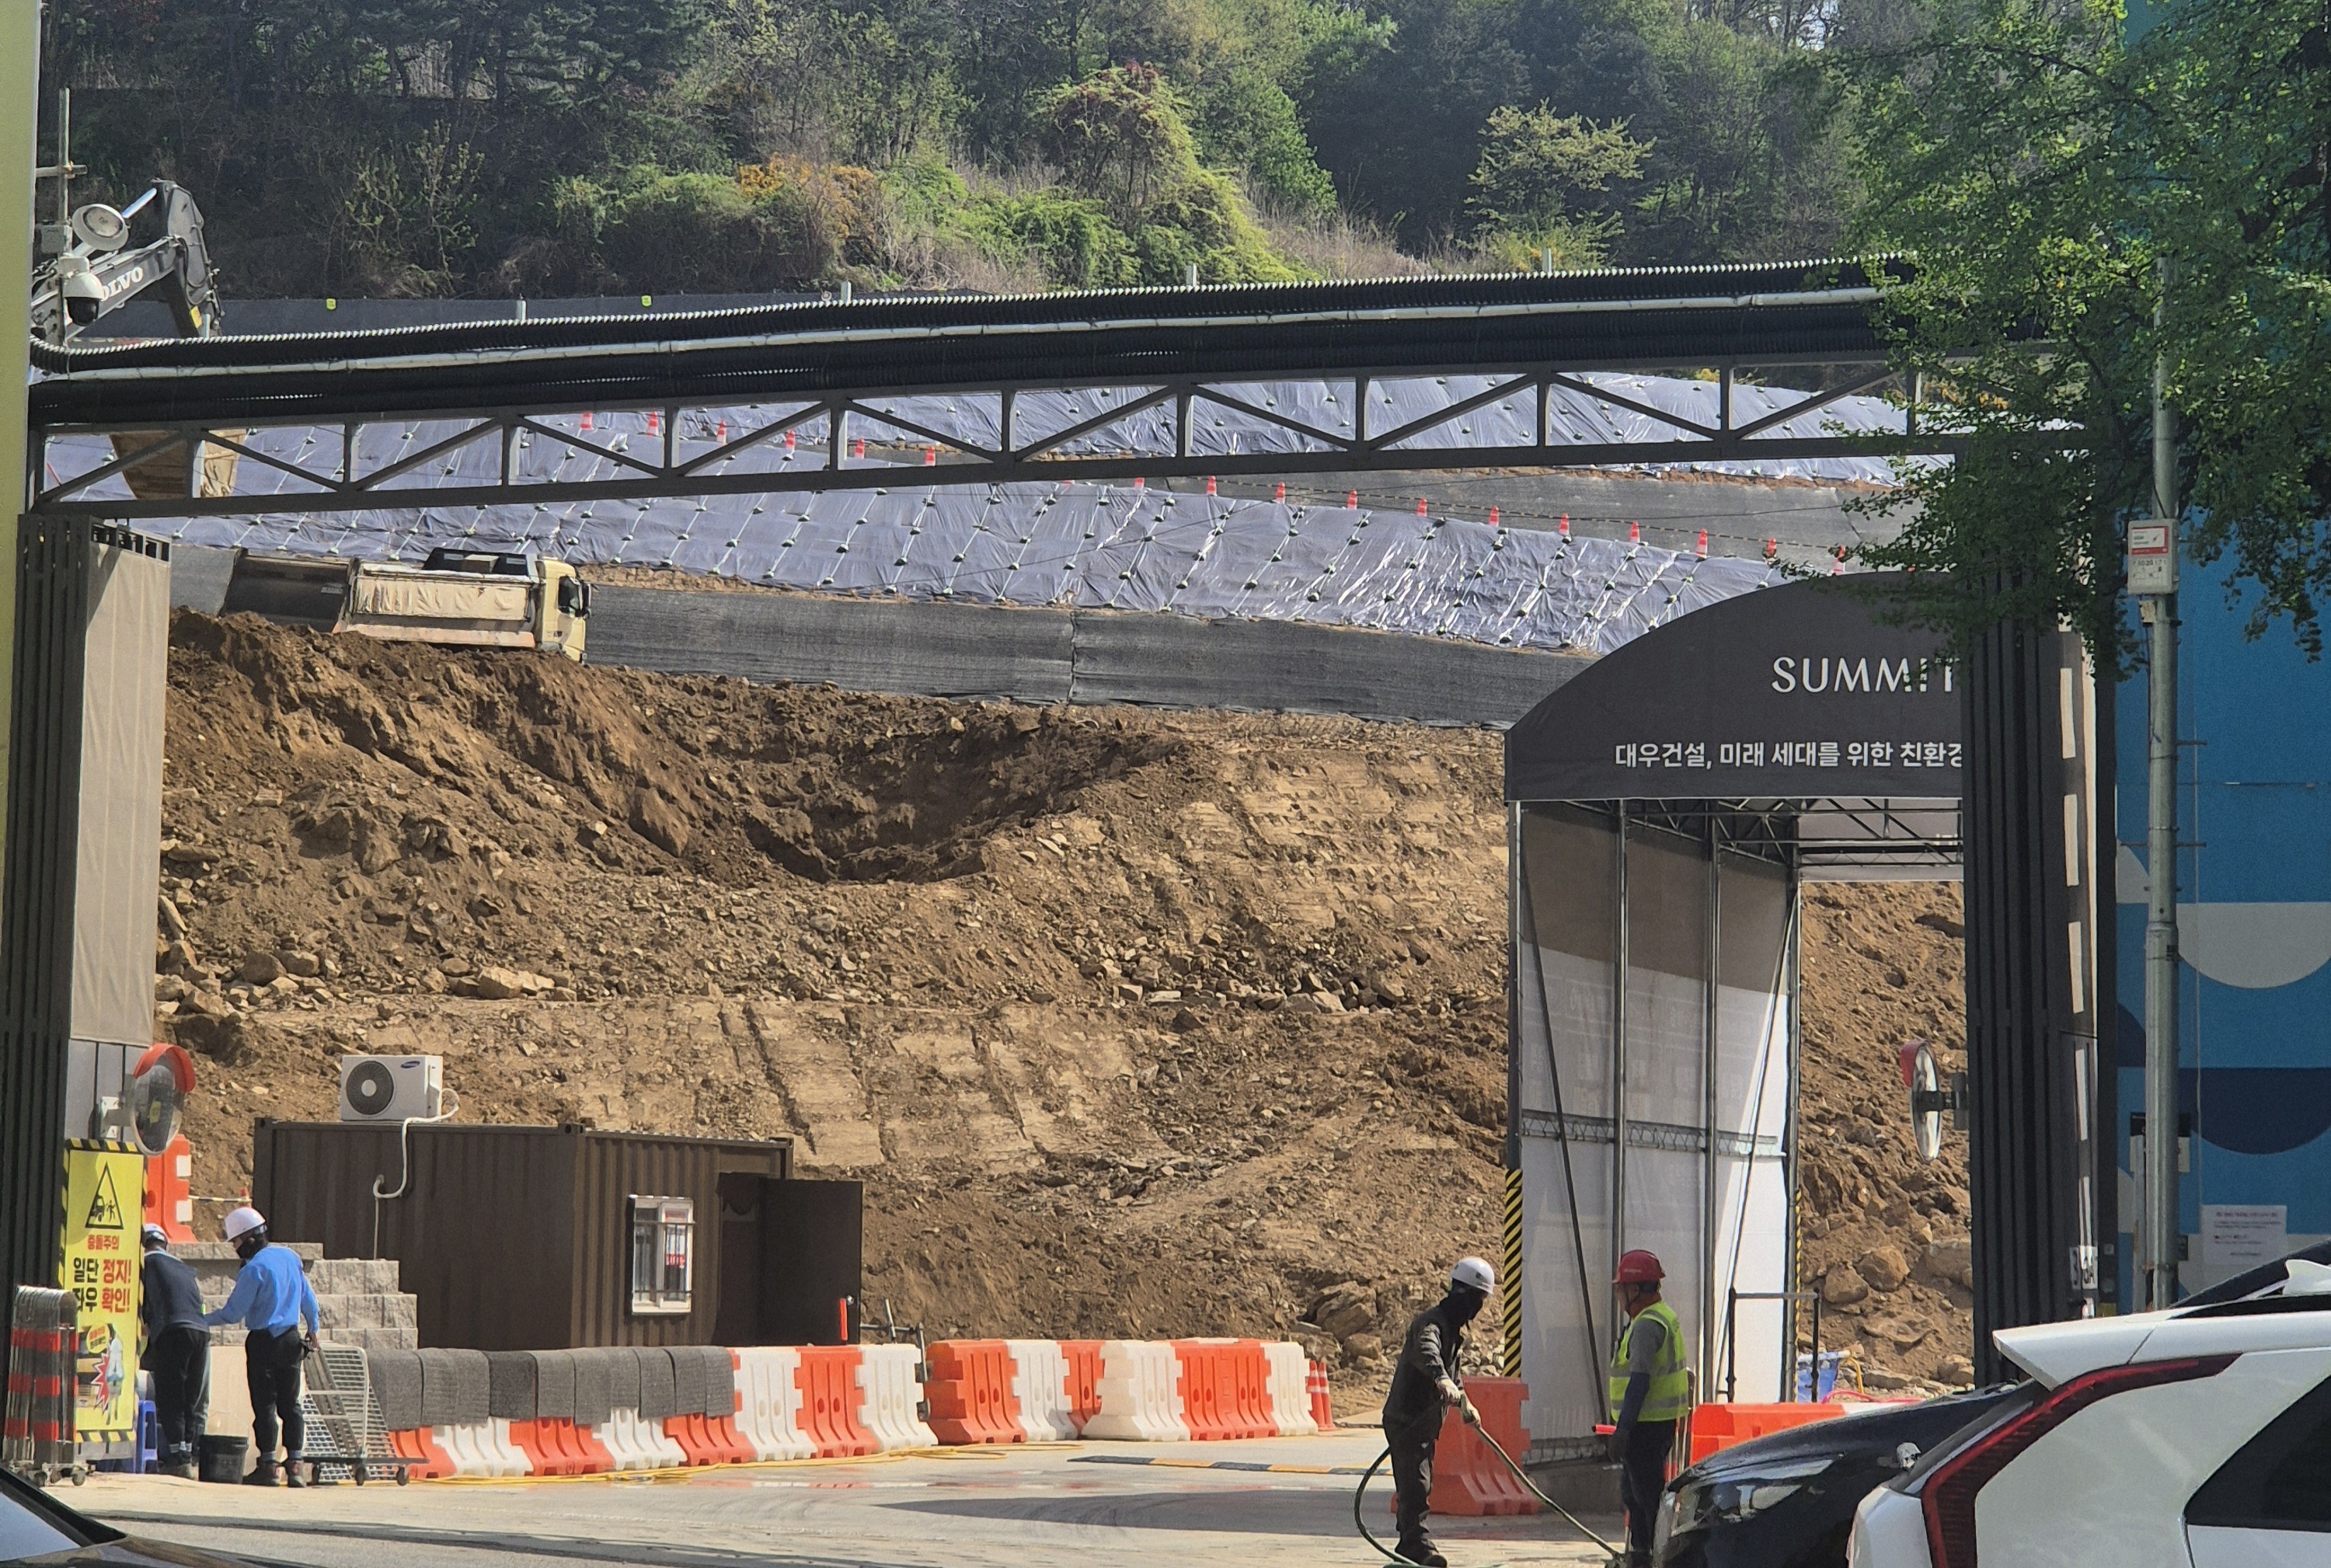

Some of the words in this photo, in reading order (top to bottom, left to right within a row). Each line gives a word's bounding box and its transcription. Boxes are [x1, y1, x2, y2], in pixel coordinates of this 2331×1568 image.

[1772, 657, 1960, 693] SUMMIT
[1615, 741, 1712, 770] 대우건설,
[1720, 741, 1765, 768] 미래
[1772, 741, 1841, 768] 세대를
[1847, 741, 1894, 768] 위한
[73, 1257, 99, 1284] 일단
[103, 1259, 132, 1284] 정지!
[101, 1287, 131, 1314] 확인!
